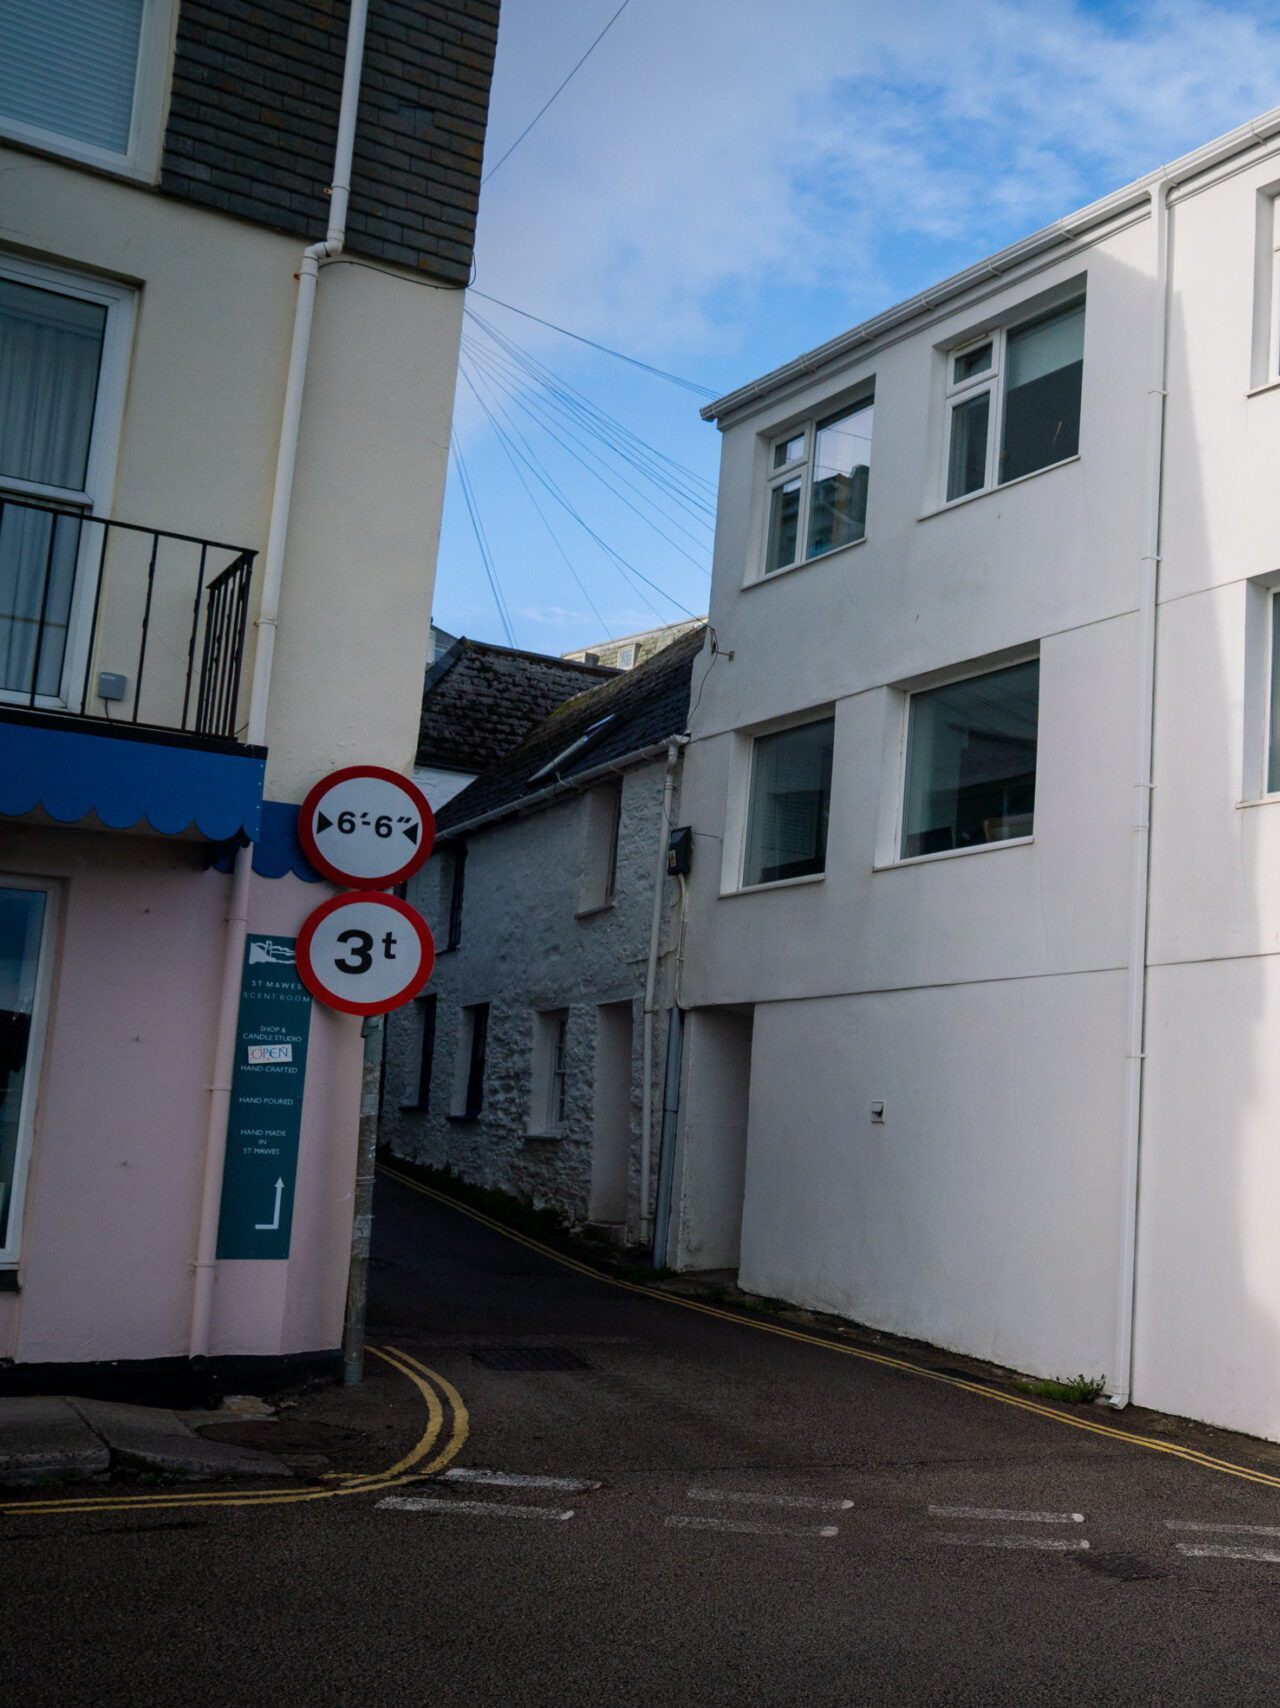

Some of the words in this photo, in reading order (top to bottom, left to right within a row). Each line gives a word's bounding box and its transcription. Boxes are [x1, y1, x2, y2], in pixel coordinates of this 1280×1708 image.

[251, 979, 263, 987] ST
[265, 981, 303, 990] MAWES
[242, 991, 276, 1000] SCENT
[279, 994, 311, 1003] ROOM
[259, 1025, 280, 1033] SHOP
[242, 1032, 273, 1041] CANDLE
[274, 1034, 303, 1042] STUDIO
[251, 1047, 288, 1059] OPEN
[240, 1064, 263, 1072] HAND
[265, 1065, 298, 1074] CRAFTED
[239, 1096, 261, 1104] HAND
[263, 1097, 294, 1106] POURED
[240, 1128, 264, 1136] HAND
[265, 1129, 286, 1137] MADE
